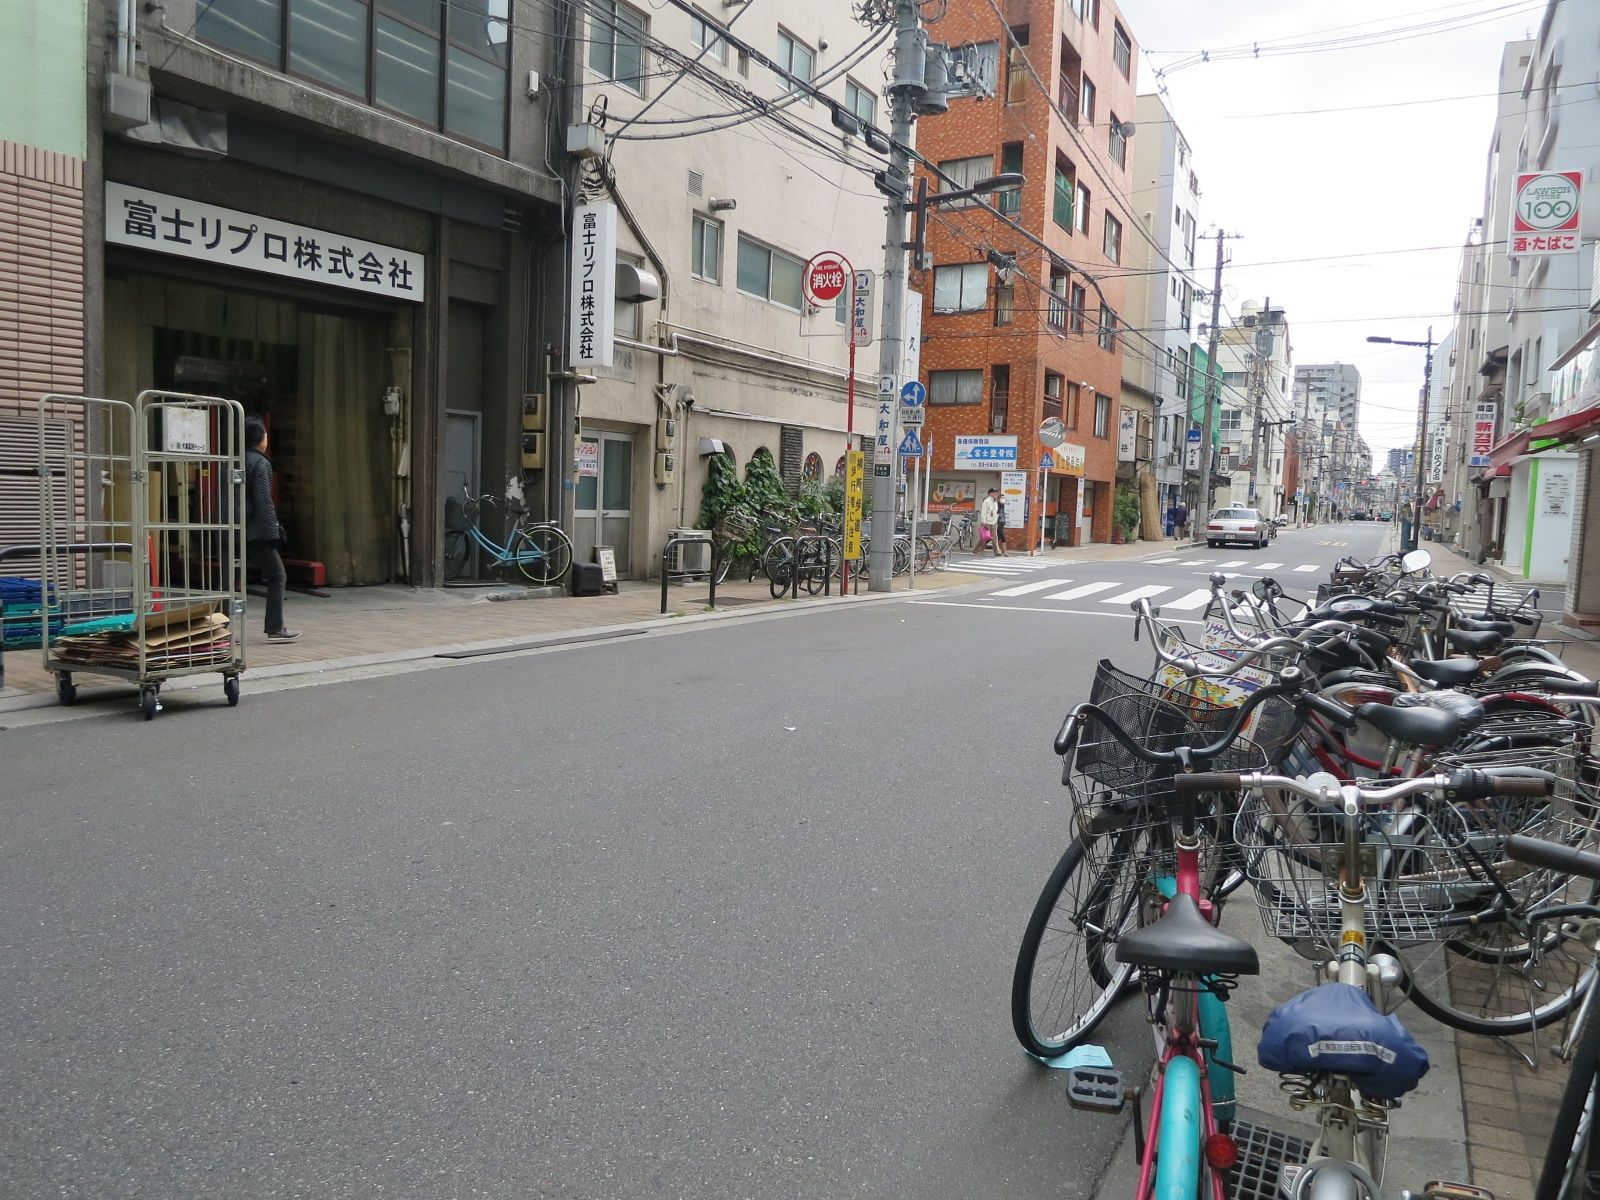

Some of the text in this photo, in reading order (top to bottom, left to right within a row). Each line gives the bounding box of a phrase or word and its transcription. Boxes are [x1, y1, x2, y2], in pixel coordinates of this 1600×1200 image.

[1526, 186, 1571, 196] LAWSON
[1535, 193, 1561, 201] STORE
[1525, 200, 1572, 220] 100
[123, 199, 413, 291] 富士リプロ株式会社
[579, 212, 597, 359] 富士リプロ株式会社
[812, 271, 843, 289] 消火栓
[854, 297, 866, 328] 大和屋
[877, 403, 890, 446] 大和屋
[973, 448, 1014, 458] 富士整骨院
